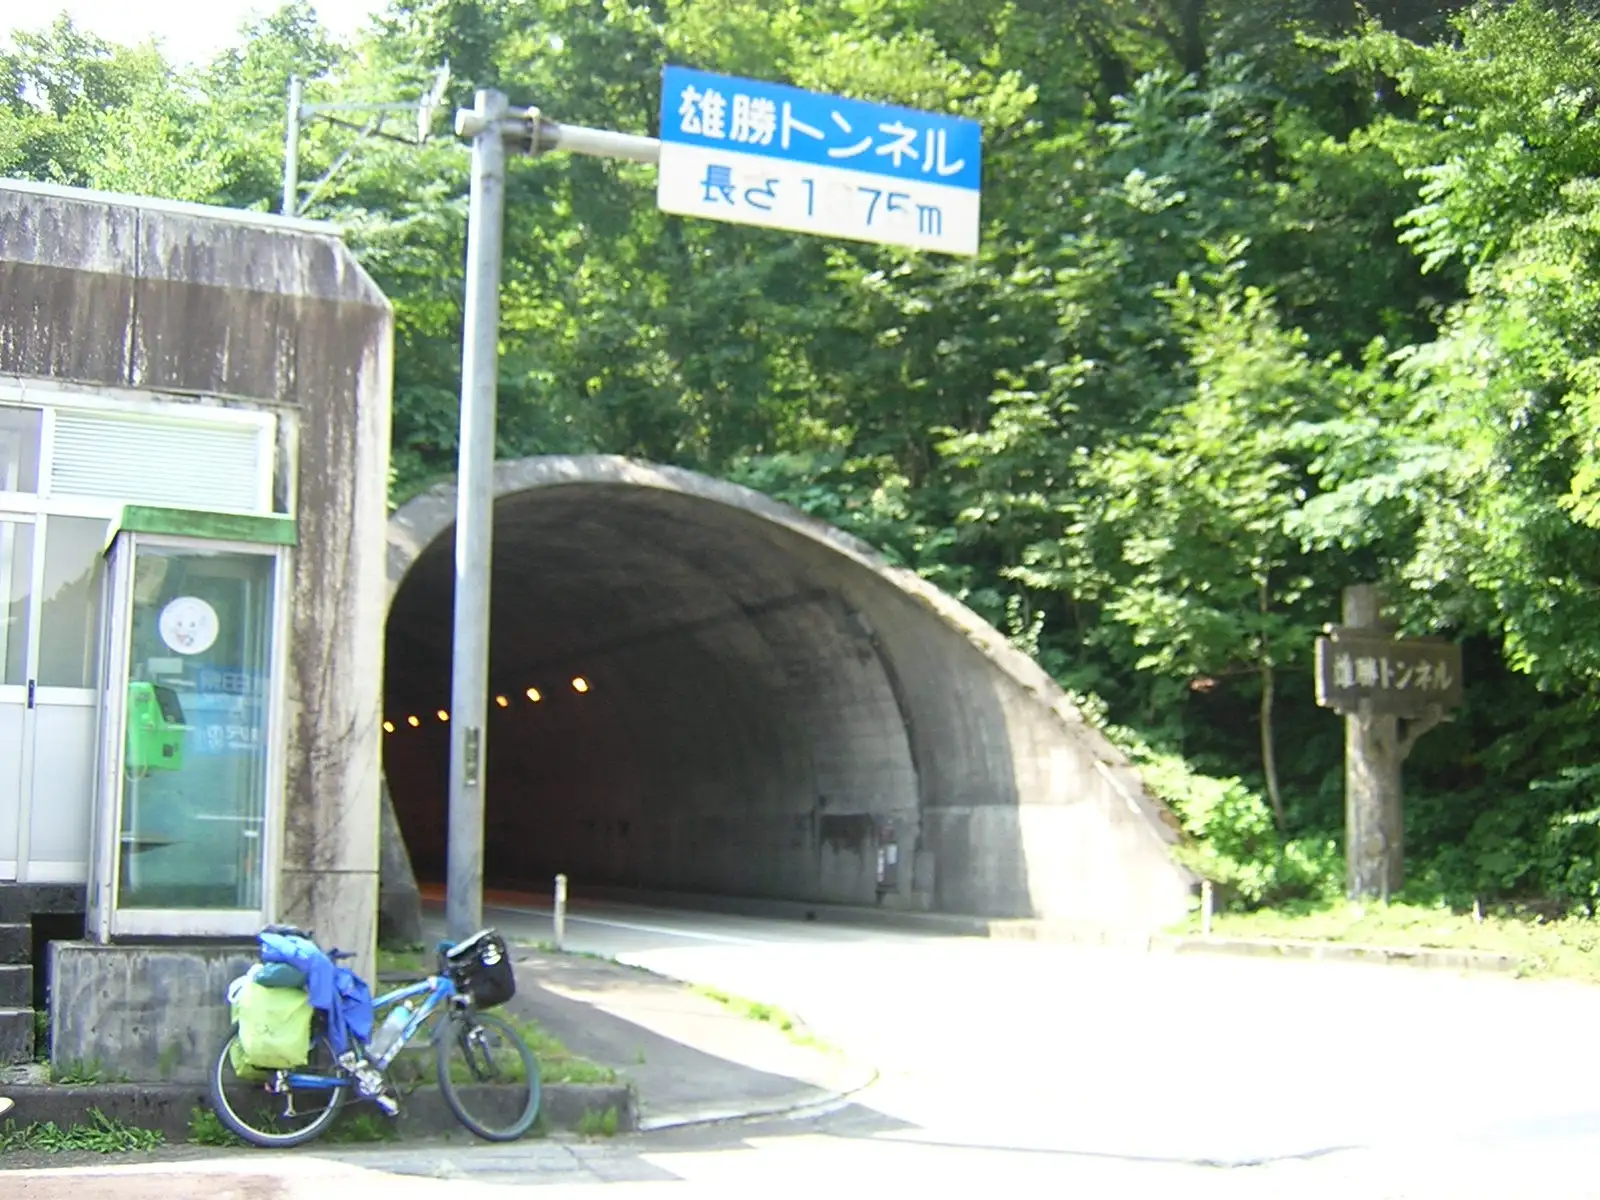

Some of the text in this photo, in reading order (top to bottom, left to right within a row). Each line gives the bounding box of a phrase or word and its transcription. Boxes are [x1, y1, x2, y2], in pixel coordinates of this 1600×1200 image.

[678, 84, 965, 176] 雄勝トンネル
[701, 164, 942, 236] 長さ175m
